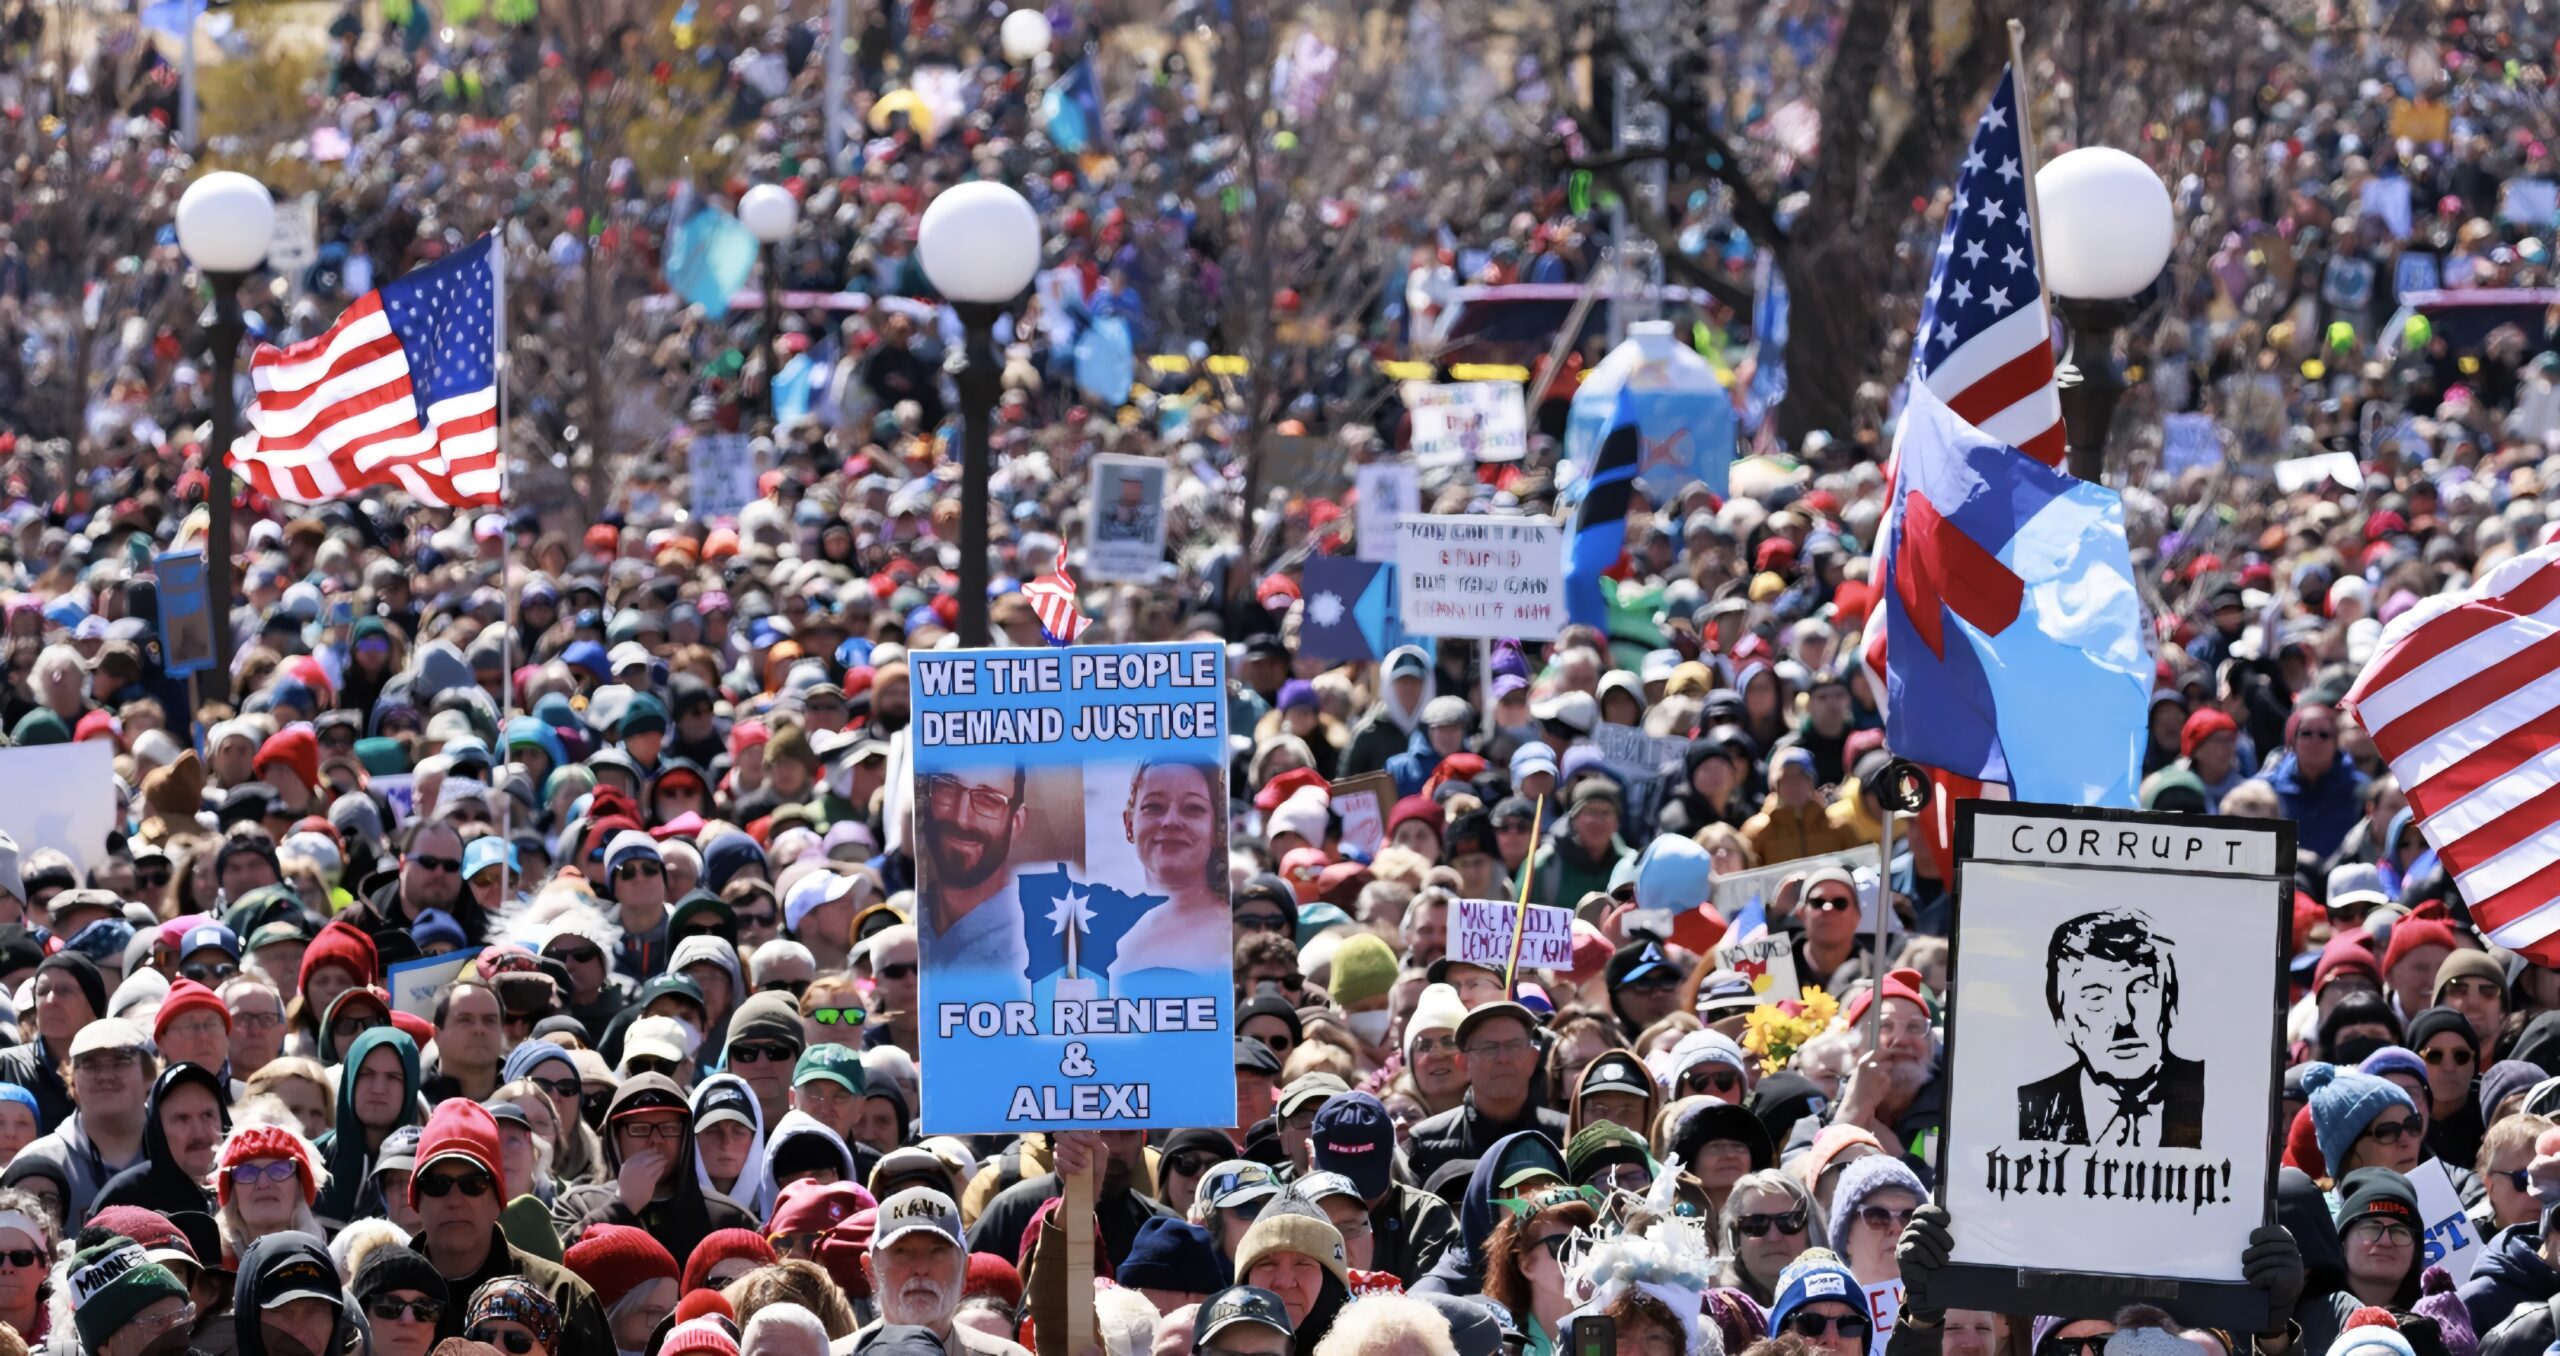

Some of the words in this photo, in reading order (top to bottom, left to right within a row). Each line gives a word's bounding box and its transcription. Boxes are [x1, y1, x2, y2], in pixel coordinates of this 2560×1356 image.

[918, 660, 976, 696] WE
[985, 657, 1062, 694] THE
[1071, 652, 1216, 690] PEOPLE
[922, 707, 1063, 746] DEMAND
[1072, 702, 1218, 741] JUSTICE
[2012, 825, 2242, 866] CORRUPT
[1460, 901, 1497, 931] MAKE
[939, 1000, 1038, 1038] FOR
[1053, 996, 1218, 1035] RENEE
[1059, 1041, 1097, 1078] &
[1006, 1083, 1150, 1121] ALEX!
[2084, 1150, 2231, 1216] trump!
